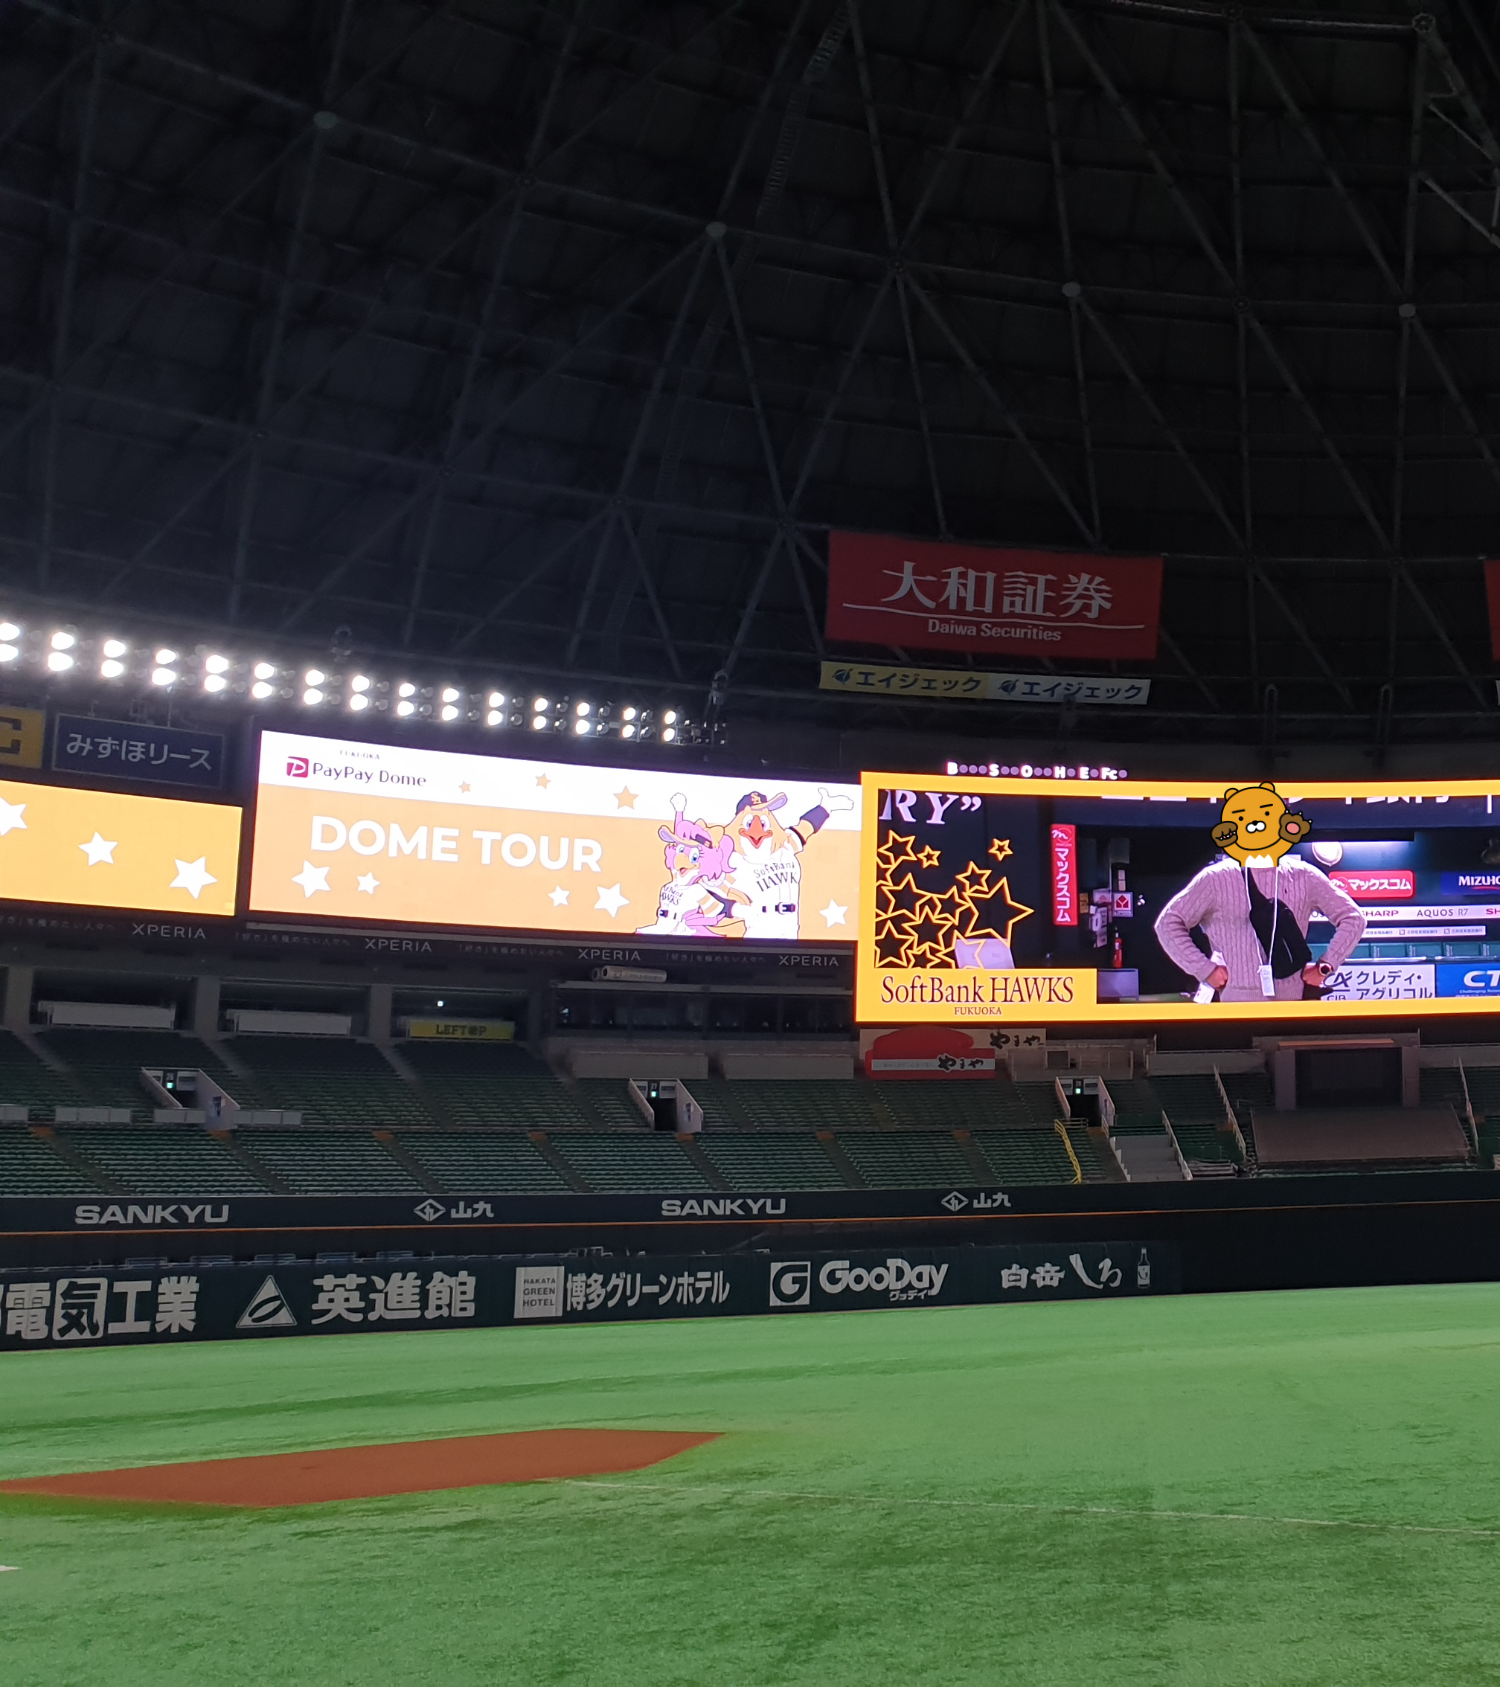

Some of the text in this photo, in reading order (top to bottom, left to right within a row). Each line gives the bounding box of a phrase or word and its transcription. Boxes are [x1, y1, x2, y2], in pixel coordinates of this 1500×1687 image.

[881, 560, 1113, 619] 大和証券
[928, 619, 1062, 642] Daiwa Securities
[856, 670, 982, 693] エイジェック
[1021, 680, 1144, 700] エイジェック
[65, 732, 213, 771] みずほリース
[313, 762, 427, 787] PayPay Dome
[948, 762, 958, 775] B
[990, 764, 1000, 777] S
[1055, 766, 1066, 779] H
[1080, 767, 1090, 779] E
[310, 816, 604, 872] DOME TOUR
[1054, 847, 1073, 924] マックスコム
[1347, 877, 1412, 891] マックスコム
[1416, 907, 1454, 918] AQUOS
[132, 923, 206, 939] XPERIA
[364, 938, 433, 953] XPERIA
[578, 948, 641, 962] XPERIA
[779, 955, 839, 967] XPERIA
[881, 974, 1075, 1003] SoftBank HAWKS
[1356, 986, 1433, 1000] アグリコル
[953, 1006, 1003, 1016] FUKUOKA
[451, 1200, 495, 1219] 山九
[661, 1198, 787, 1217] SANKYU
[973, 1191, 1012, 1209] 山九
[75, 1204, 229, 1225] SANKYU
[524, 1277, 556, 1285] HAKATA
[819, 1258, 949, 1296] GooDay
[311, 1270, 478, 1325] 英進館
[523, 1287, 556, 1296] GREEN
[566, 1270, 731, 1312] 博多グリーンホテル
[889, 1289, 930, 1302] グッデイ
[0, 1274, 201, 1342] 電気工業
[522, 1298, 555, 1307] HOTEL
